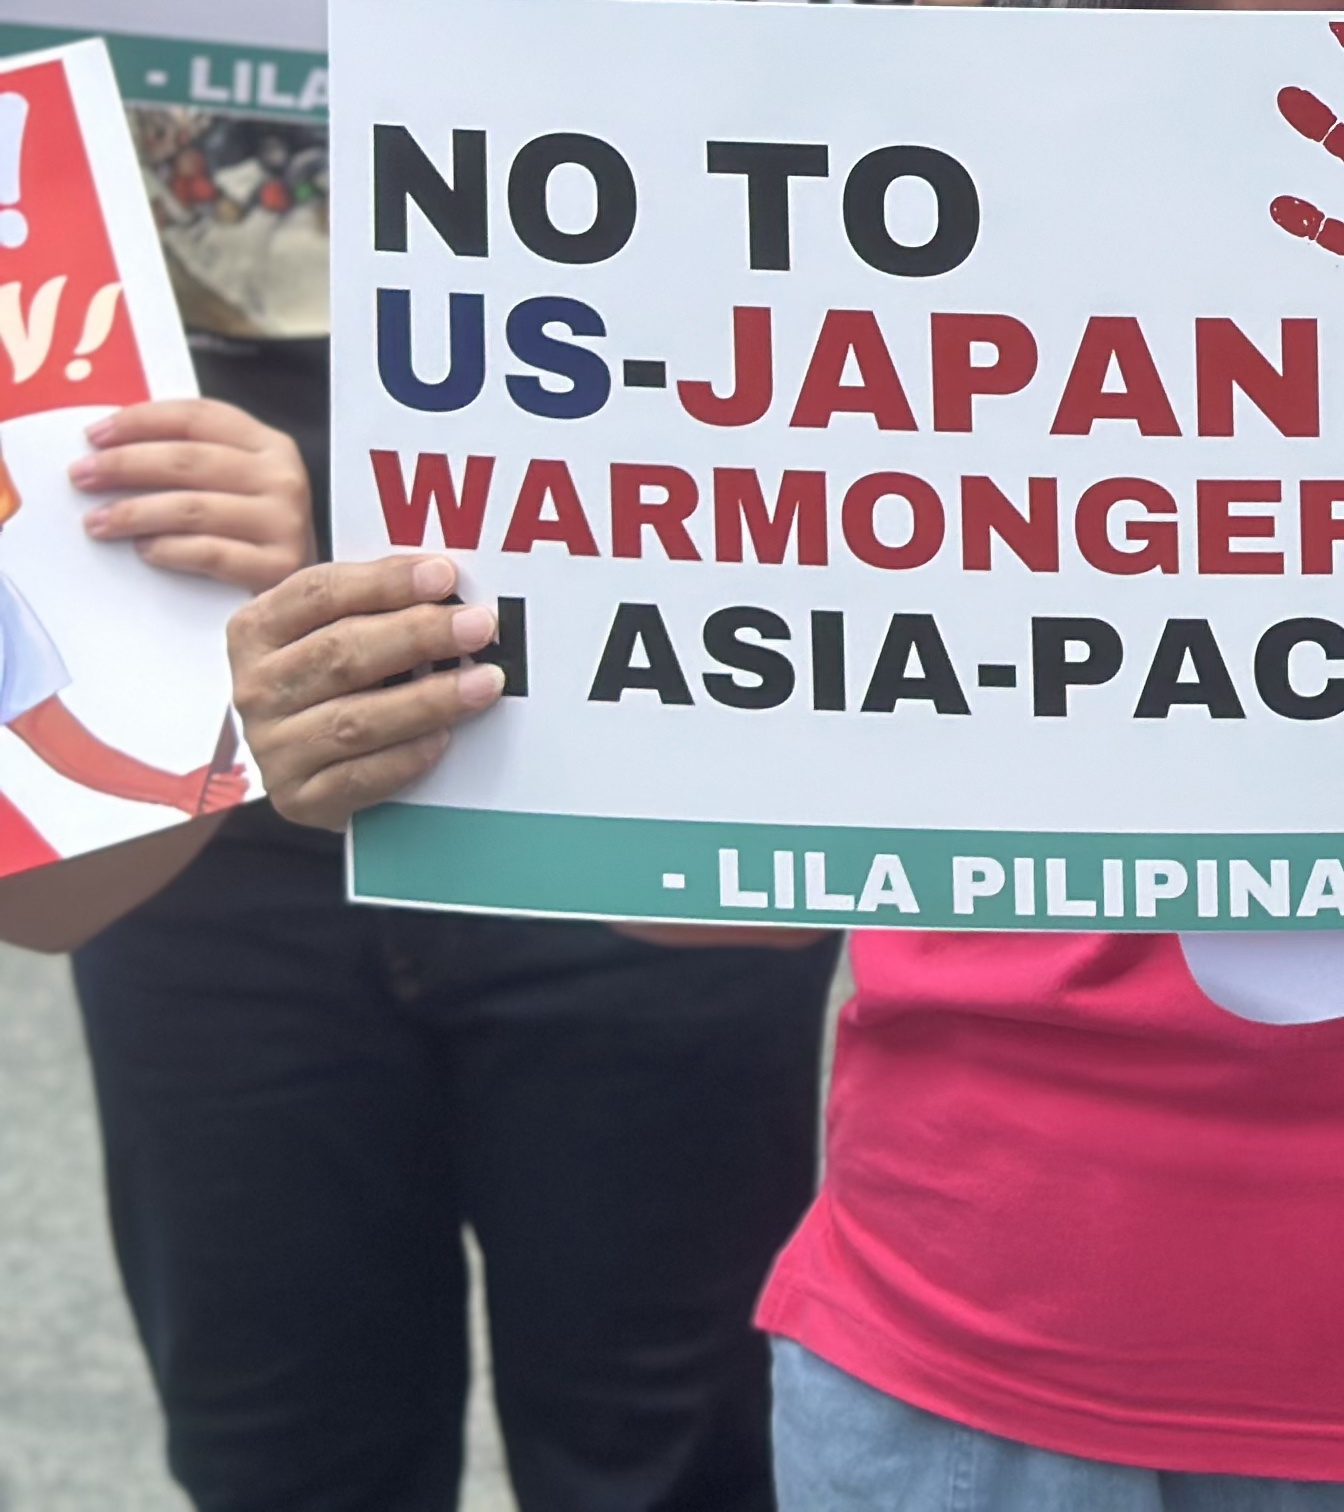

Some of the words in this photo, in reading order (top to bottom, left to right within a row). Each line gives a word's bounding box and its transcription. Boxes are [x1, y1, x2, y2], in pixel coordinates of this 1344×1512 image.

[374, 124, 637, 265] NO
[707, 141, 980, 277] TO
[376, 287, 1320, 438] US-JAPAN
[718, 848, 920, 914] LILA
